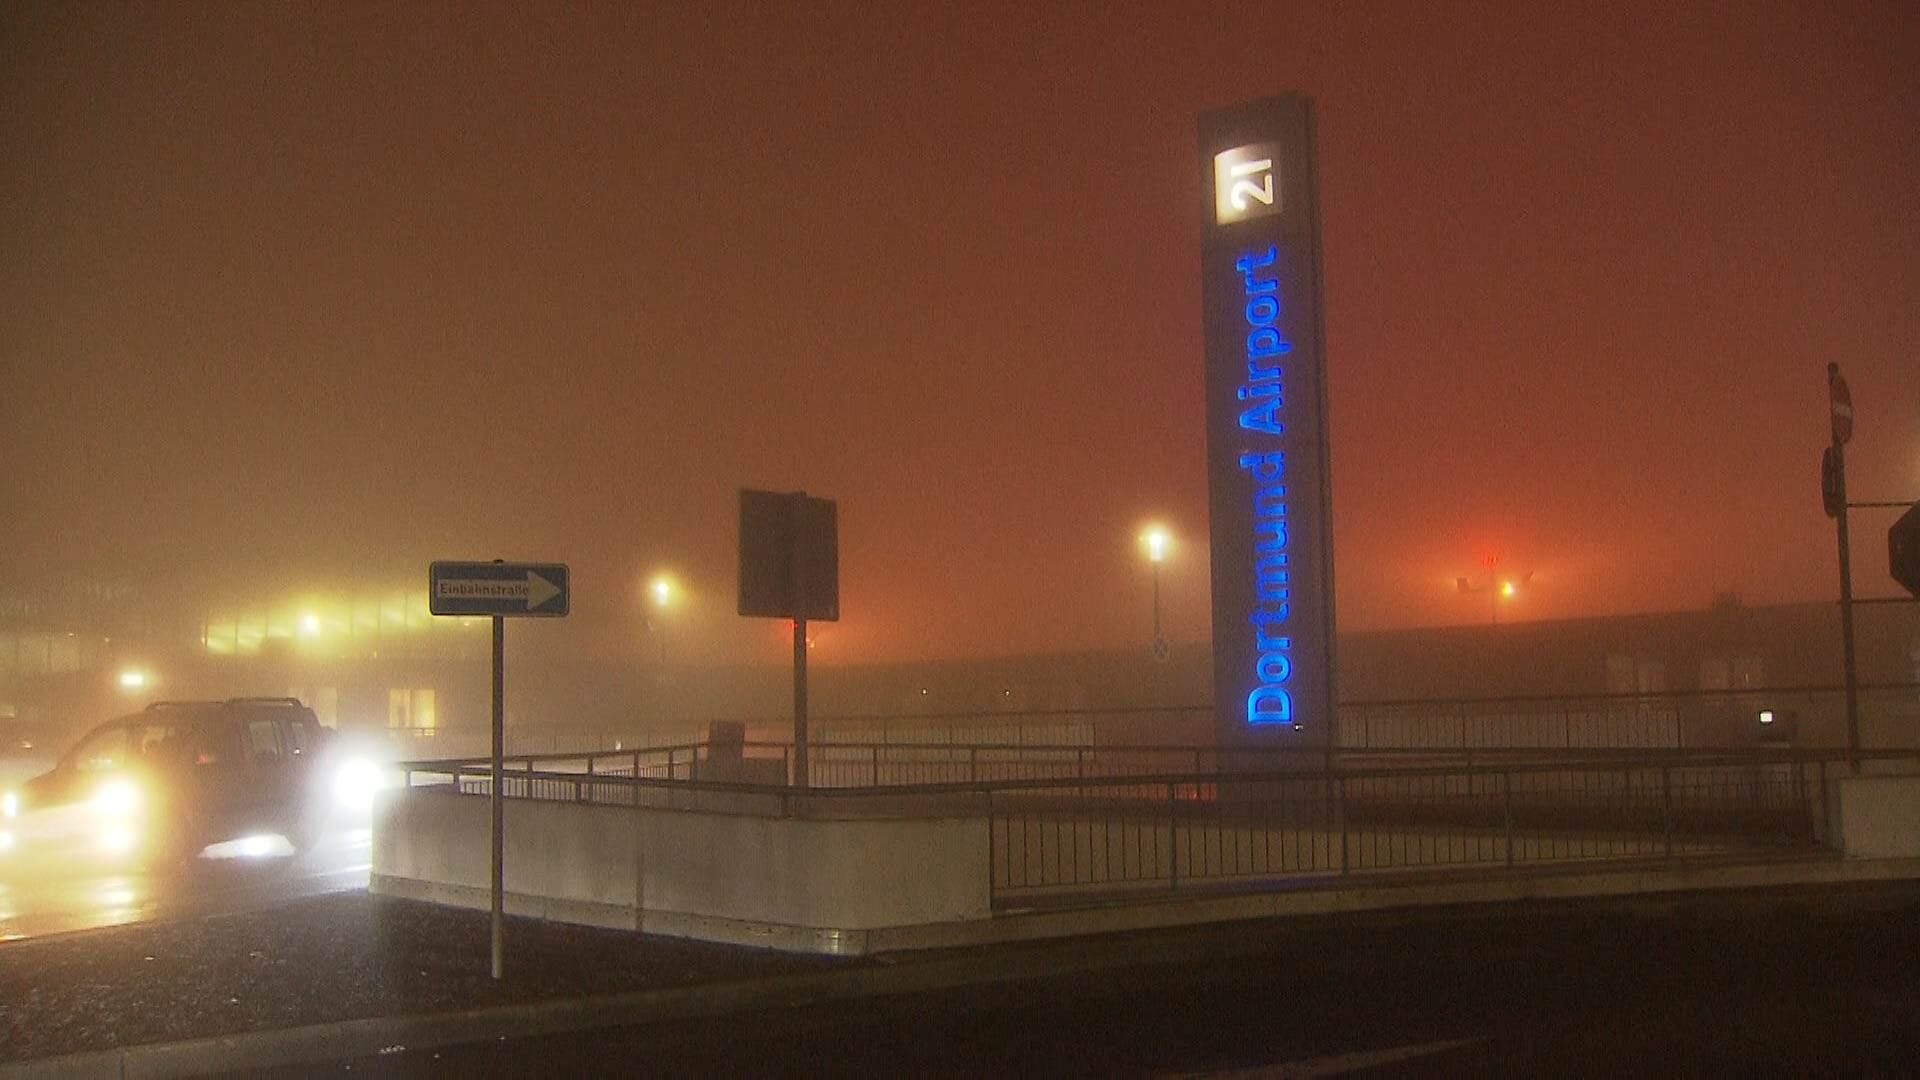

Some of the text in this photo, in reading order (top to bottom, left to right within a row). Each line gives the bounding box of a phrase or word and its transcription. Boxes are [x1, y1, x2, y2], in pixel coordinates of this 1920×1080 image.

[1230, 158, 1291, 724] Dortmund Airport 21
[439, 582, 528, 597] Einbahnstraße
